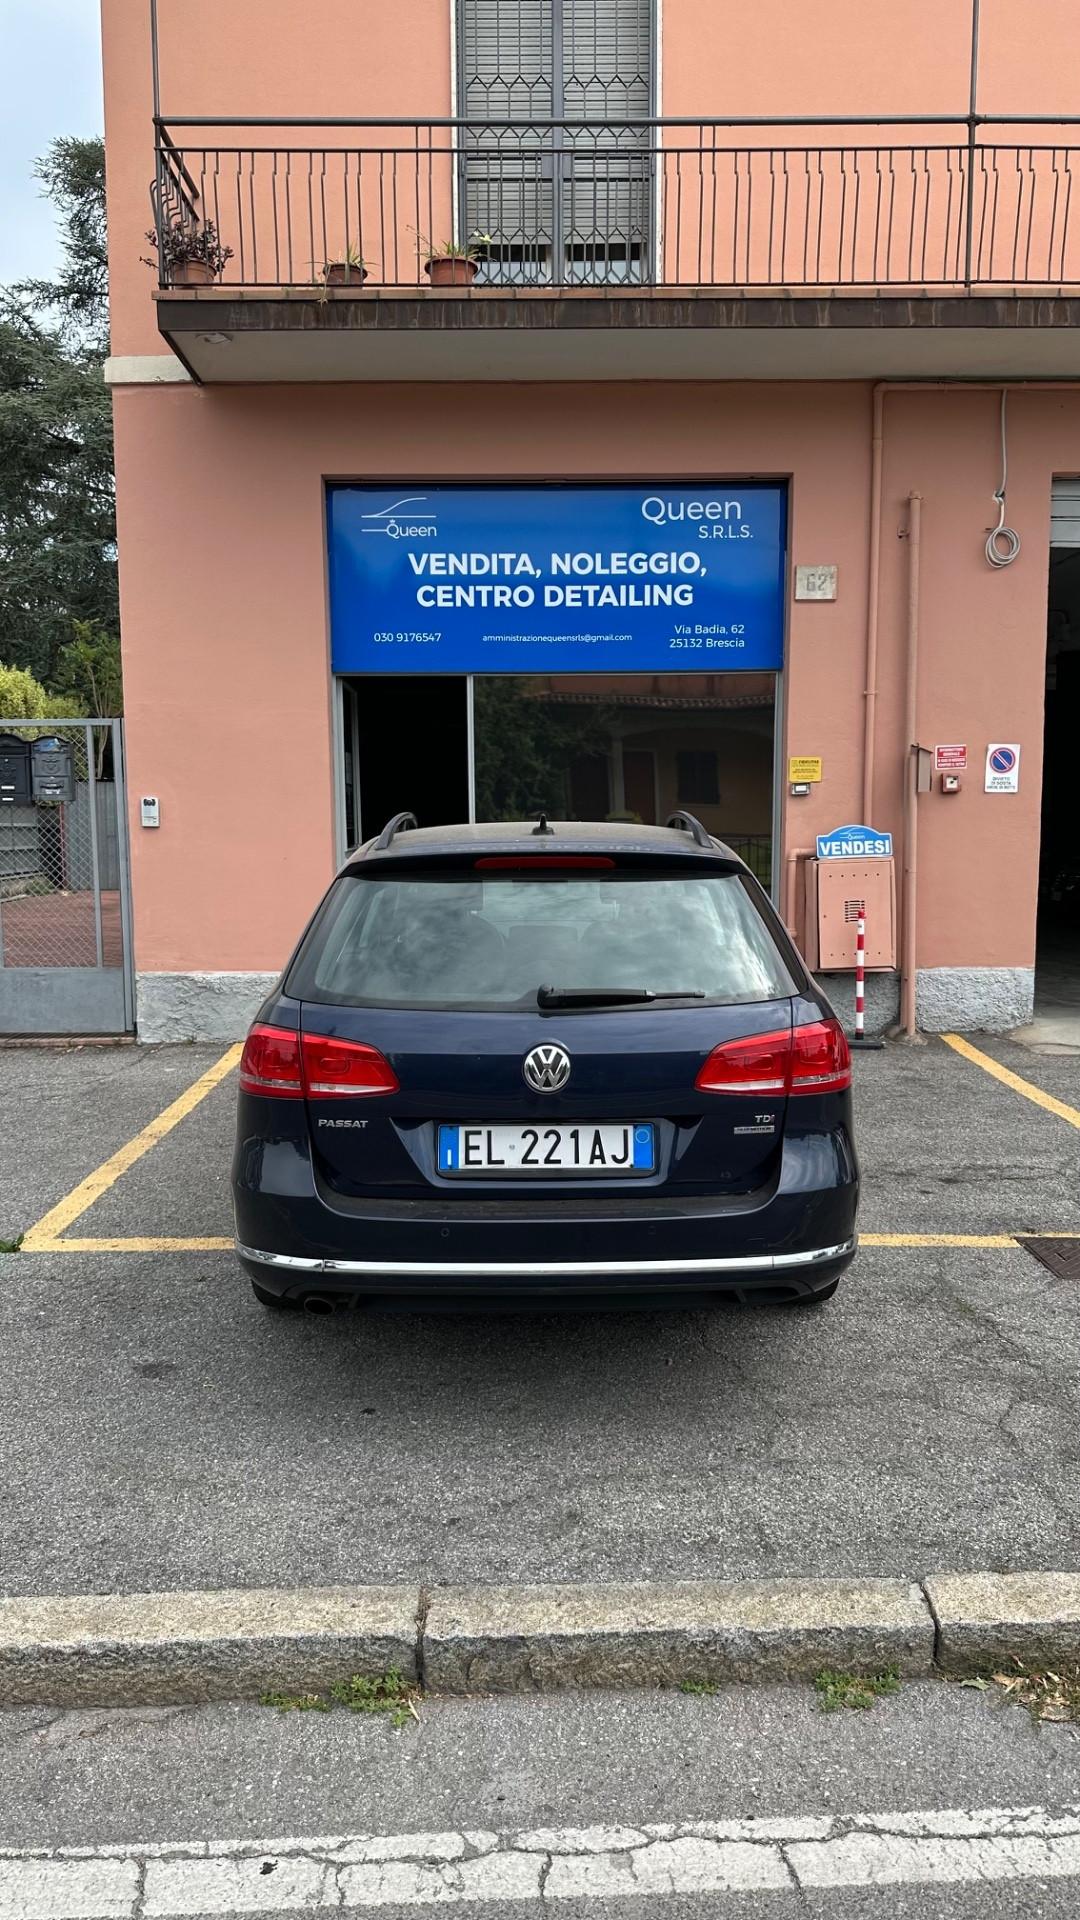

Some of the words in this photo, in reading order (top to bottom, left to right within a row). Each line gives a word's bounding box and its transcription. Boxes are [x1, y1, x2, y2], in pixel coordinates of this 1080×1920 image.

[641, 496, 742, 526] Queen
[386, 523, 437, 539] Queen
[698, 524, 754, 539] S.R.L.S.
[407, 552, 542, 578] VENDITA,
[551, 551, 707, 577] NOLEGGIO,
[416, 585, 535, 608] CENTRO
[544, 584, 693, 607] DETAILING
[374, 632, 394, 642] 030
[396, 632, 442, 642] 9176547
[674, 624, 692, 634] Via
[694, 624, 729, 635] Badia,
[731, 624, 745, 634] 62
[482, 633, 633, 644] amministrazionequeensrls@gmail.com
[669, 638, 702, 648] 25132
[705, 637, 745, 648] Brescia
[819, 839, 890, 856] VENDESI
[318, 1119, 369, 1128] PASSAT
[464, 1129, 505, 1166] EL
[520, 1128, 630, 1165] 221AJ
